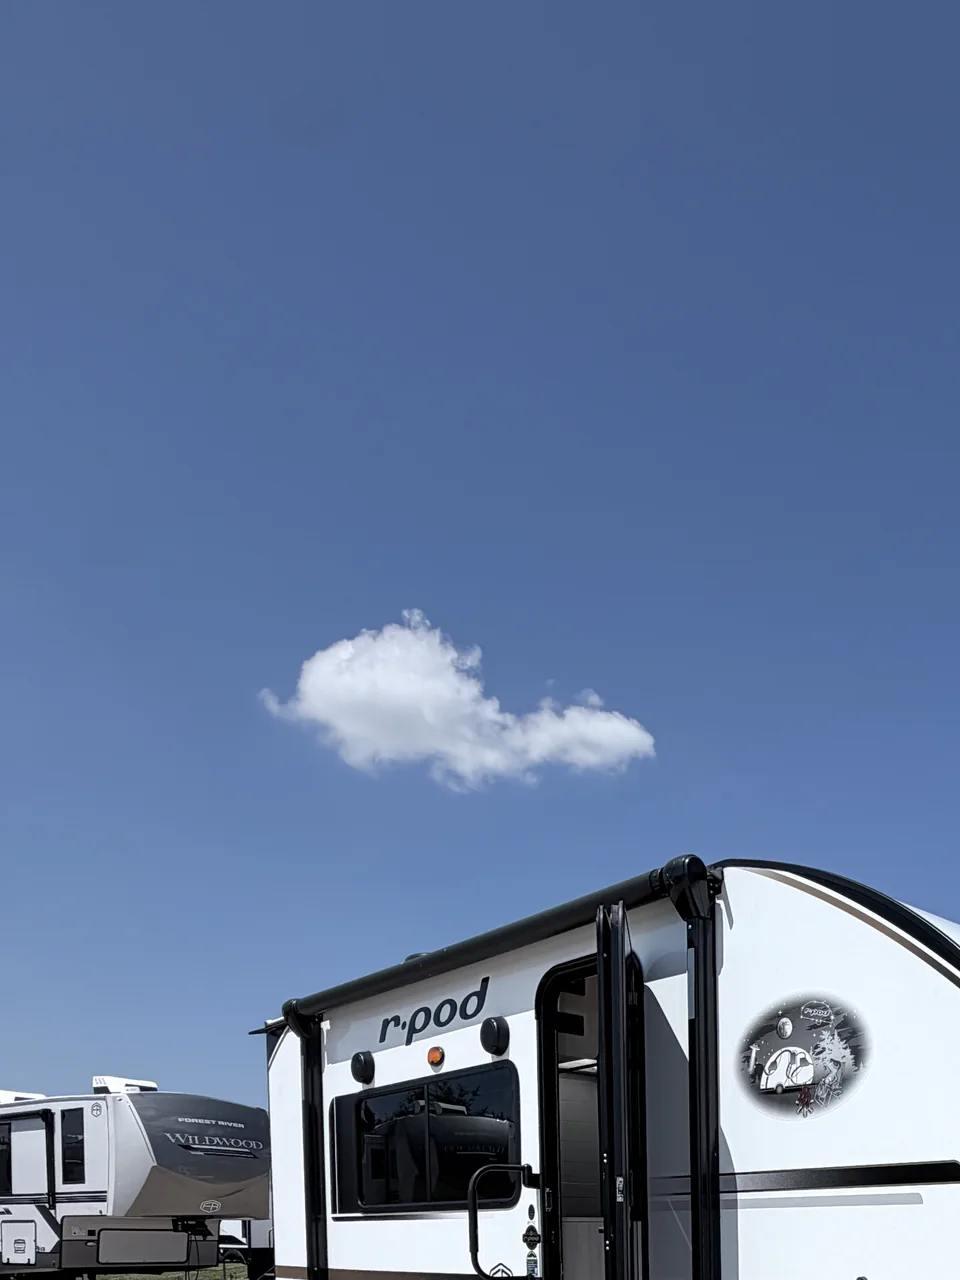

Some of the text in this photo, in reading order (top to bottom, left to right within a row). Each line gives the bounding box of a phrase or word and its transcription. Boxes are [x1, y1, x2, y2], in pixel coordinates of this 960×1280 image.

[177, 1117, 245, 1129] FOREST RIVER
[163, 1132, 264, 1150] WILDWOOD
